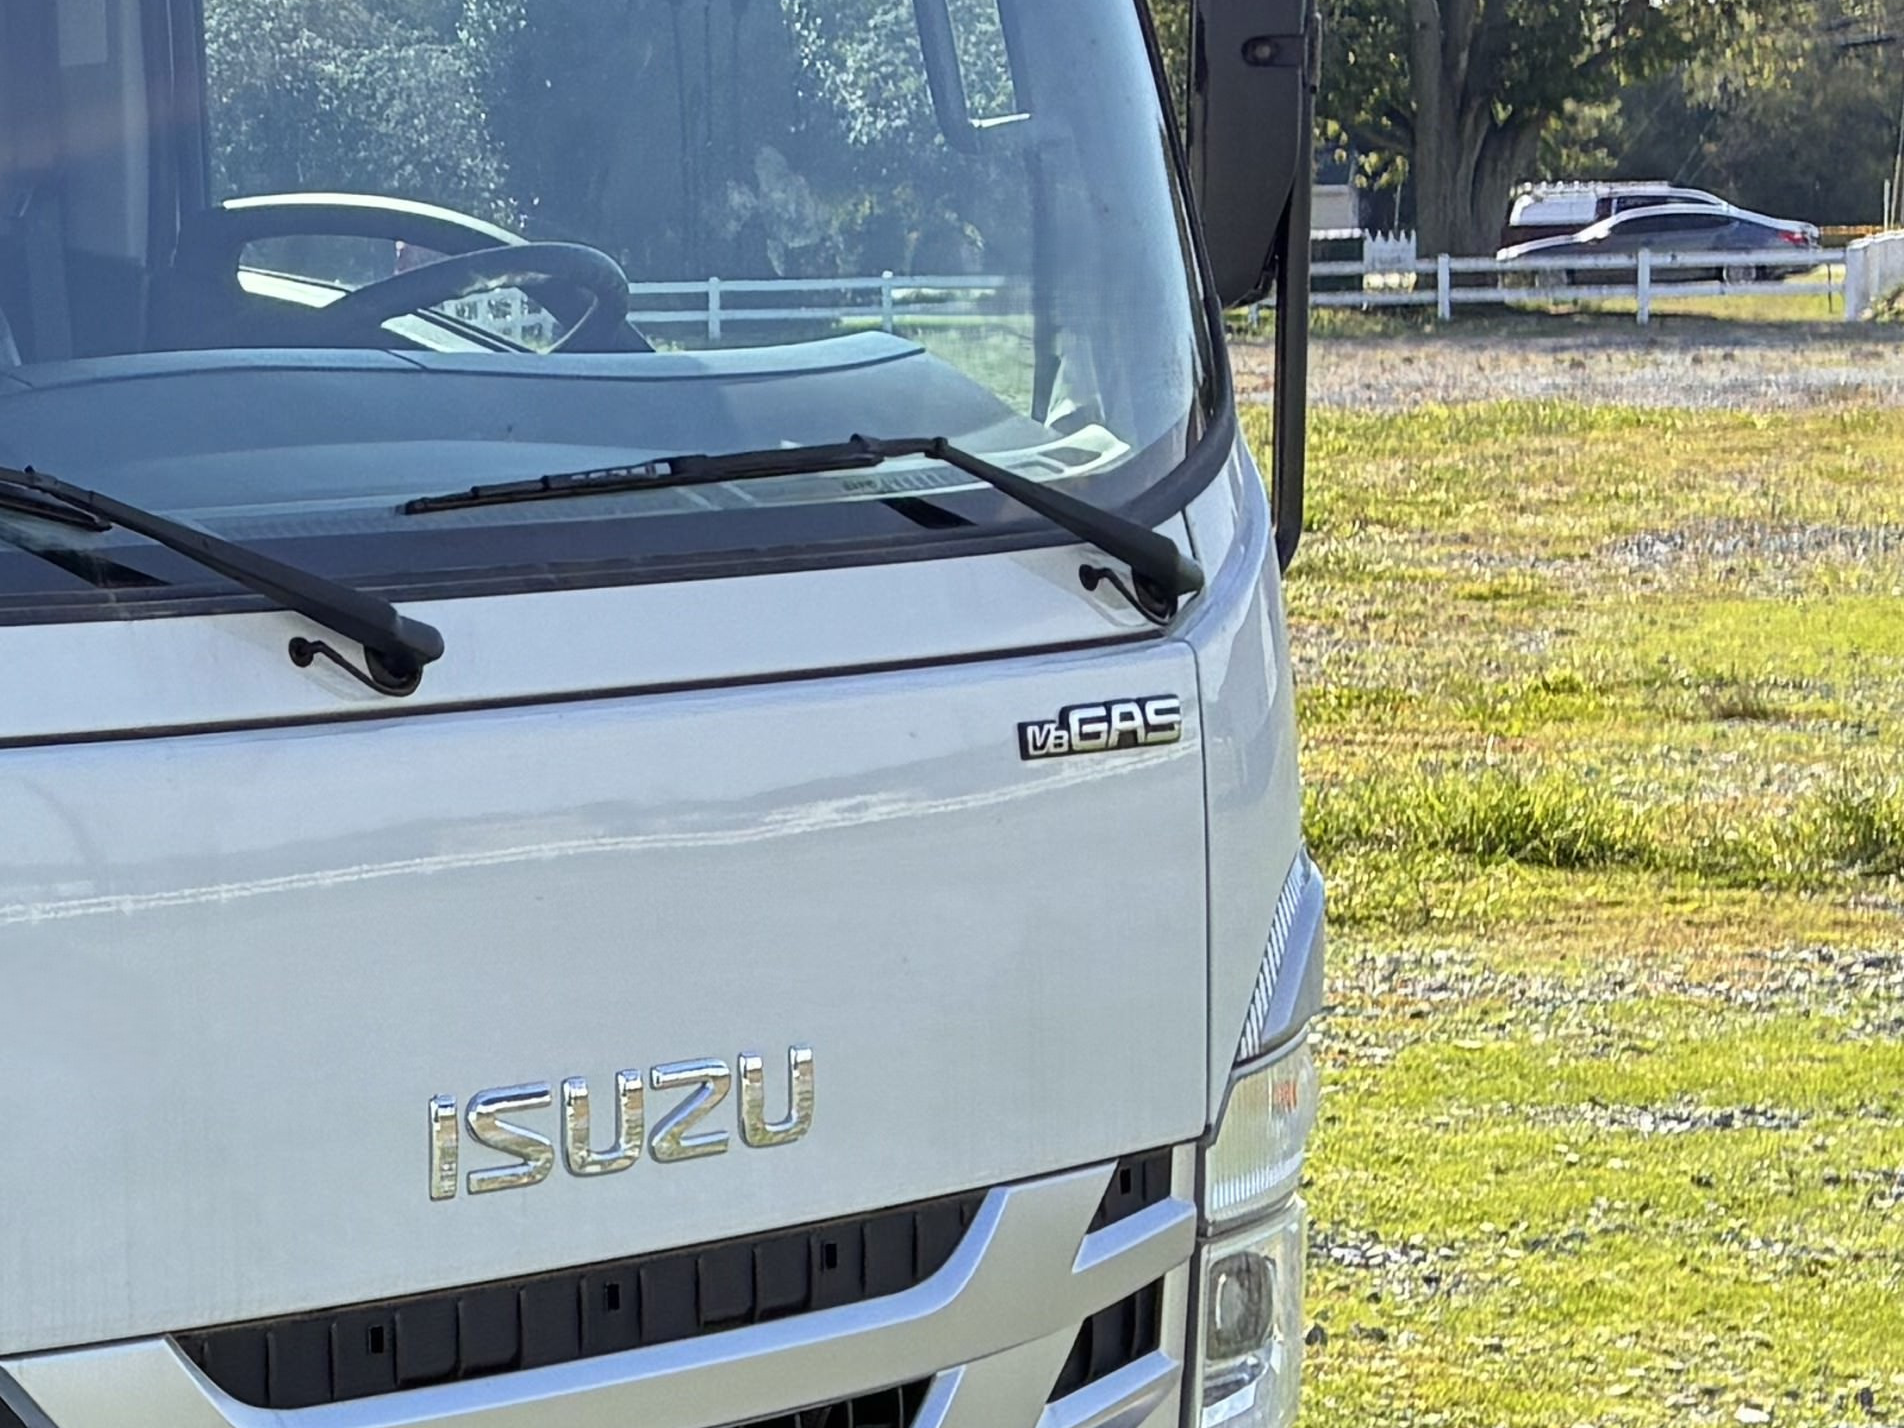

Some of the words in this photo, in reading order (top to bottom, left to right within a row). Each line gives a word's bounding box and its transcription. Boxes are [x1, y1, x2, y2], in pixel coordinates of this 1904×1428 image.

[1027, 723, 1069, 755] V8
[1069, 698, 1182, 752] GAS
[428, 1042, 815, 1201] ISUZU
